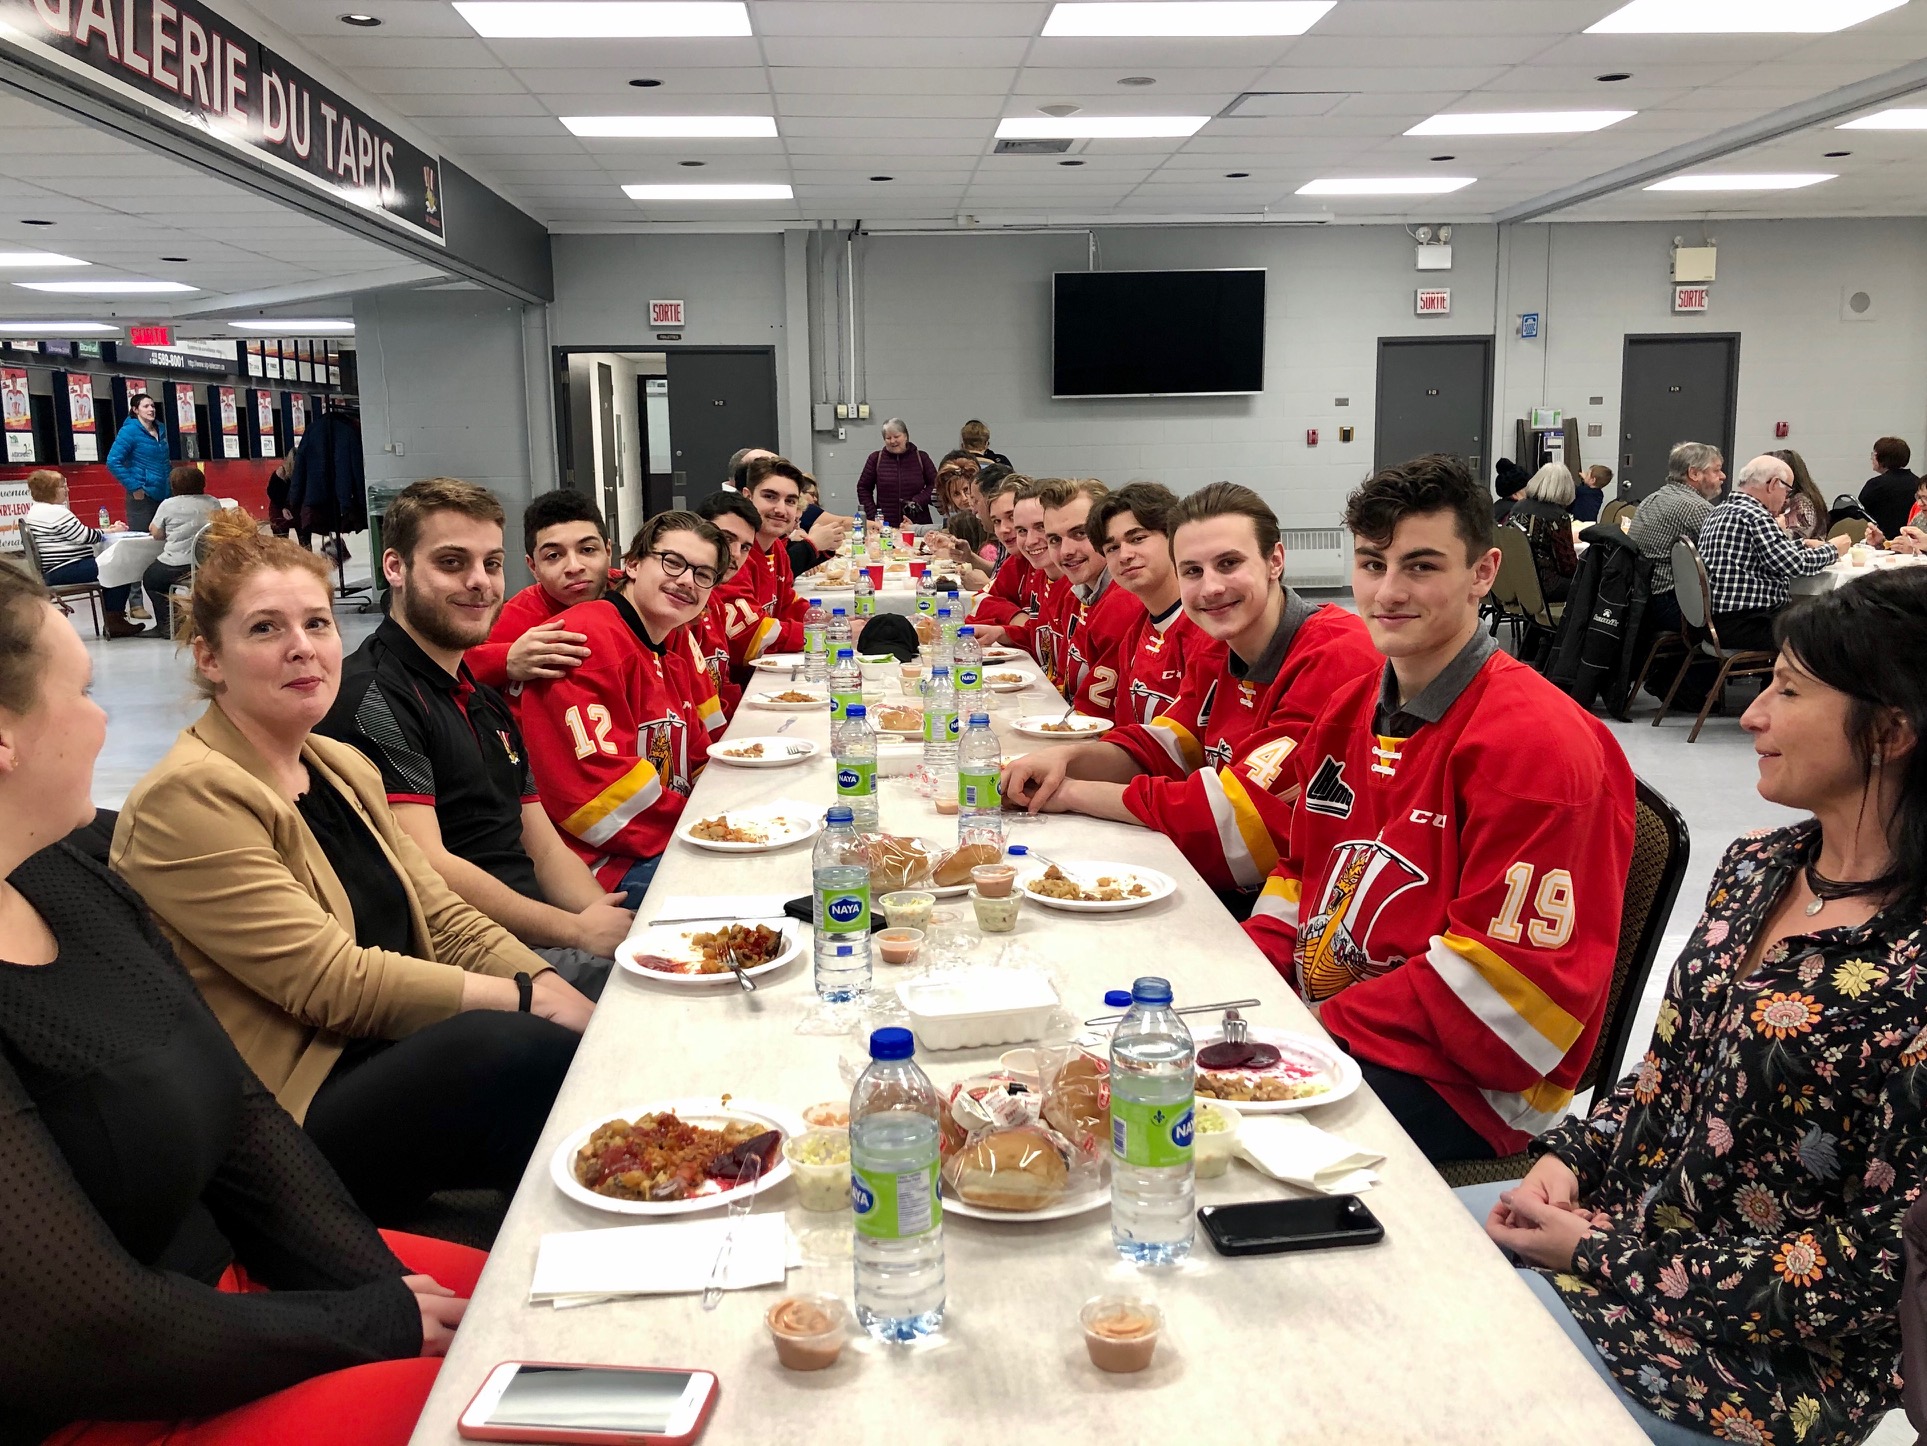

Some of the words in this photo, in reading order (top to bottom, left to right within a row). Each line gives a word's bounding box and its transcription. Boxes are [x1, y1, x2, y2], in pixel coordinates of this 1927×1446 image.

[261, 69, 312, 160] DU
[319, 101, 397, 202] TAPIS
[1420, 291, 1447, 310] SORTIE
[1678, 289, 1706, 308] SORTIE
[652, 303, 682, 322] SORTIE
[725, 598, 760, 640] 21
[564, 703, 619, 761] 12
[838, 774, 857, 783] NAYA
[831, 904, 860, 915] NAYA
[1486, 860, 1576, 950] 19
[852, 1185, 871, 1208] AYA
